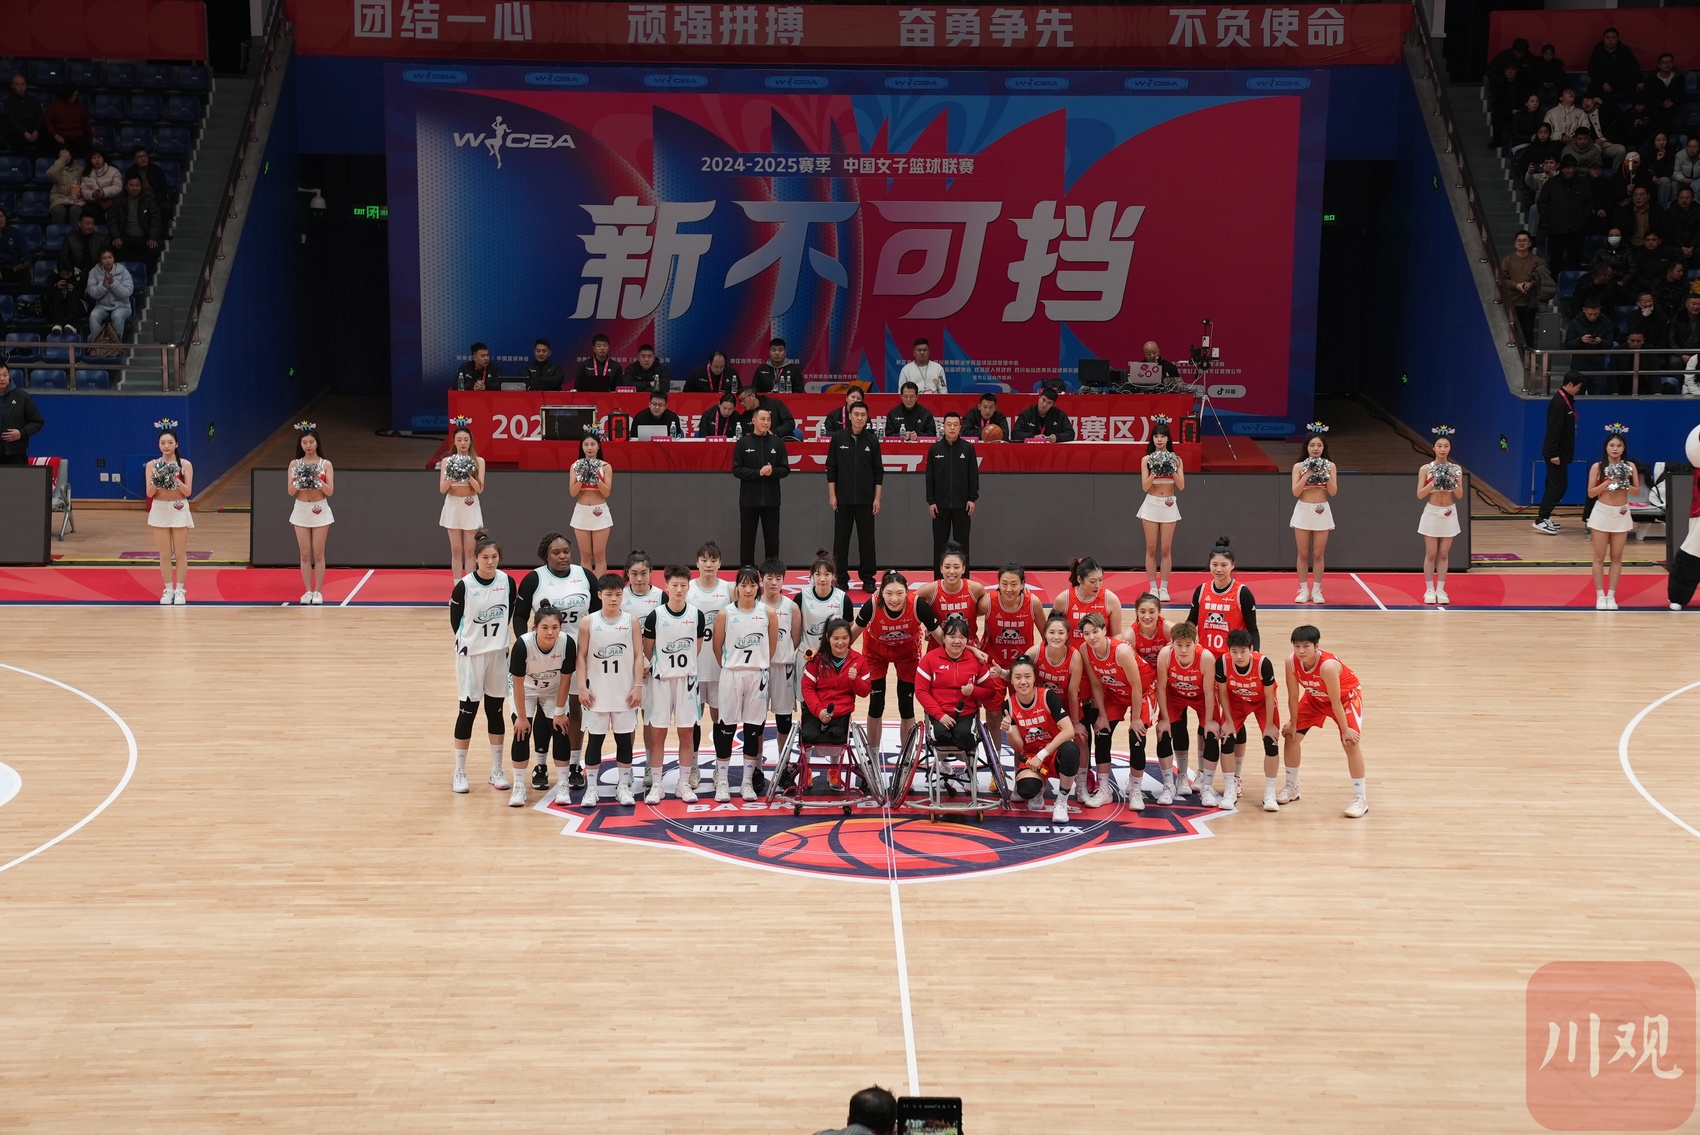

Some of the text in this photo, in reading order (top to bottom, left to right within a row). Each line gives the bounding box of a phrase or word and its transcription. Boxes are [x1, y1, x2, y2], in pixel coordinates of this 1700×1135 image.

[353, 1, 1347, 49] 团结一心 顽强拼搏 奋勇争先 不负使命
[701, 156, 975, 175] 2024-2025赛季 中国女子篮球联赛
[567, 196, 1146, 323] 新不可挡
[562, 611, 578, 624] 25
[482, 623, 500, 637] 17
[1207, 634, 1223, 648] 10
[668, 654, 688, 668] 10
[743, 650, 753, 664] 7
[1001, 649, 1020, 660] 12
[601, 660, 619, 674] 11
